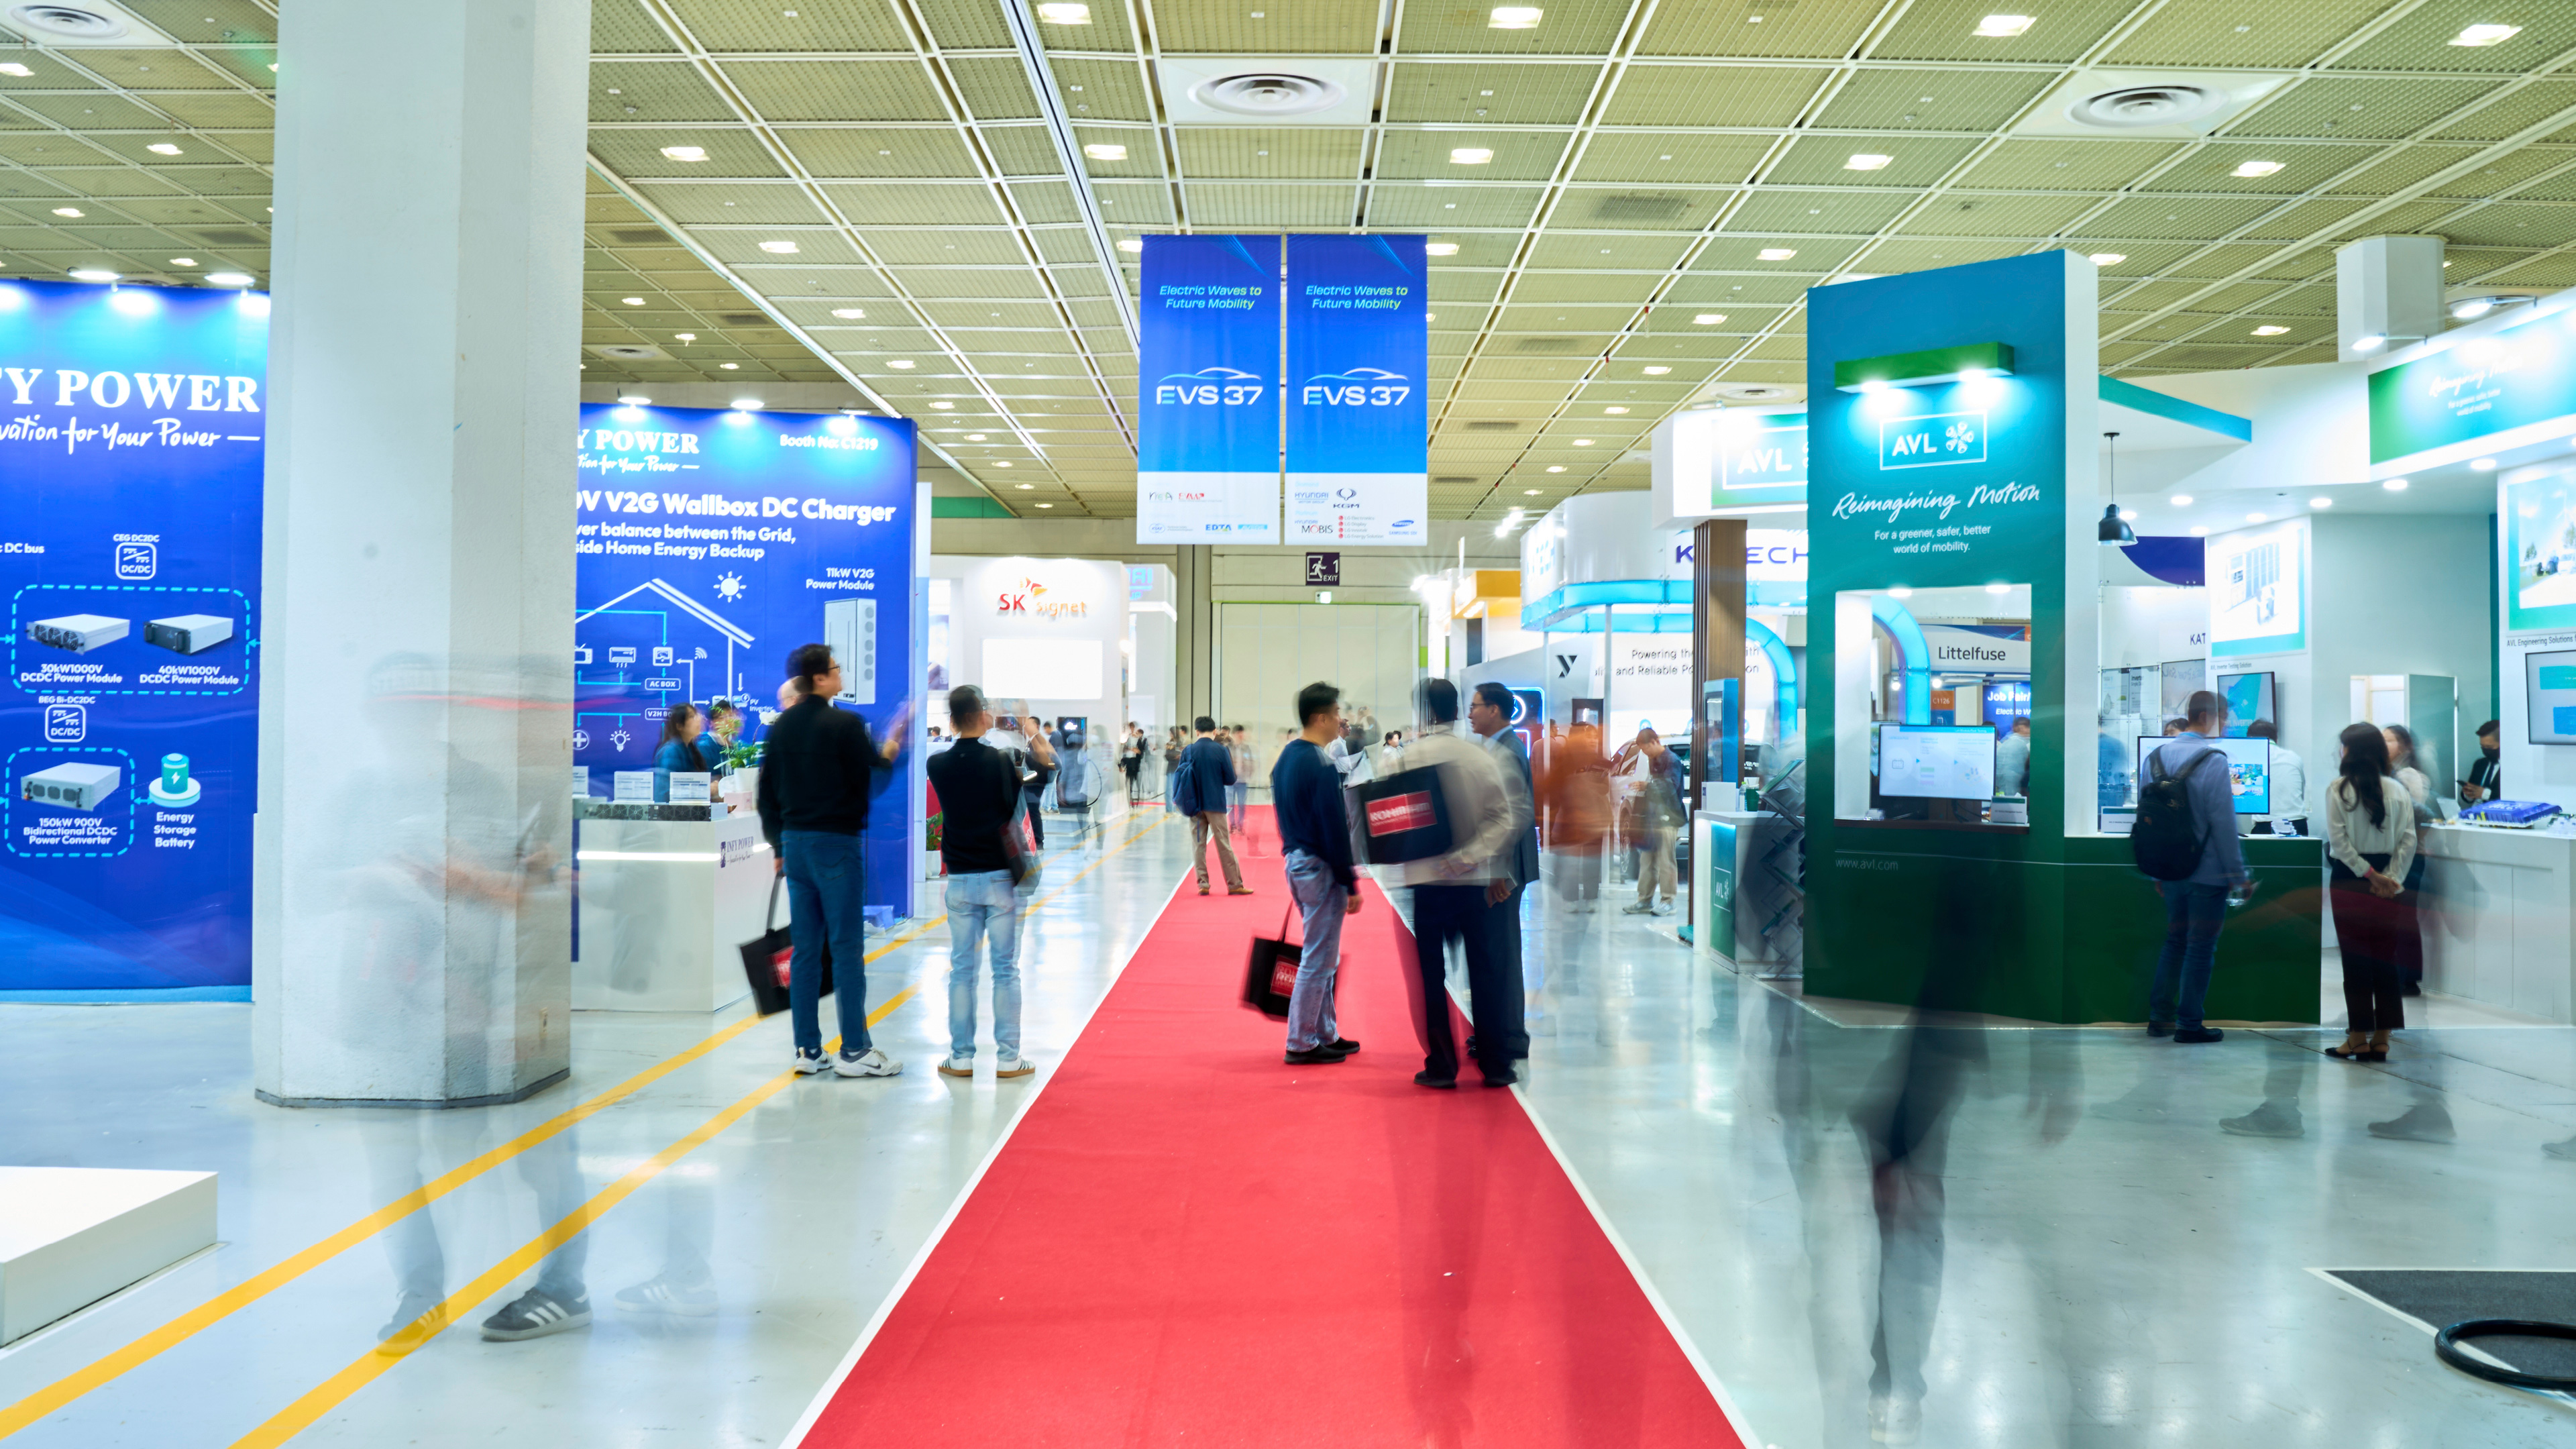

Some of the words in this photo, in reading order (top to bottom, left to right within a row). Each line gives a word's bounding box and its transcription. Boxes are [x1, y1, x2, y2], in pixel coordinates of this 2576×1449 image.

[1159, 285, 1205, 296] Electric
[1208, 285, 1247, 296] Waves
[1250, 286, 1262, 296] to
[1305, 285, 1351, 296] Electric
[1354, 285, 1393, 296] Waves
[1396, 286, 1408, 296] to
[1166, 299, 1205, 309] Future
[1208, 299, 1254, 310] Mobility
[1312, 299, 1351, 309] Future
[1354, 299, 1401, 310] Mobility
[0, 368, 43, 405] Y
[55, 370, 260, 413] POWER
[1157, 385, 1219, 406] EVS
[1224, 385, 1263, 406] 37
[1303, 386, 1366, 406] EVS
[1371, 386, 1409, 406] 37
[62, 417, 99, 455] for
[101, 422, 153, 450] Your
[152, 417, 221, 447] Power
[595, 429, 700, 454] POWER
[780, 434, 816, 448] Booth
[841, 437, 878, 450] C1219
[1892, 433, 1937, 456] AVL
[644, 455, 680, 472] Power
[1737, 448, 1792, 474] AVL
[1832, 490, 1961, 523] Reimagining
[1968, 481, 2040, 508] Motion
[605, 492, 659, 514] V2G
[662, 494, 759, 518] Wallbox
[763, 497, 798, 519] DC
[802, 499, 896, 526] Charger
[602, 522, 661, 538] balance
[664, 524, 728, 540] between
[731, 527, 756, 541] the
[758, 528, 796, 544] Grid,
[1301, 525, 1333, 533] MOBIS
[1874, 530, 1890, 541] For
[1899, 529, 1935, 542] greener,
[1937, 526, 1962, 537] safer,
[1964, 525, 1991, 536] better
[113, 534, 130, 542] CEG
[131, 535, 160, 543] DC2DC
[4, 543, 23, 553] DC
[25, 543, 44, 553] bus
[606, 541, 651, 555] Home
[654, 542, 708, 559] Energy
[710, 544, 765, 561] Backup
[1893, 544, 1919, 553] world
[1920, 543, 1930, 552] of
[1932, 542, 1970, 553] mobility.
[121, 565, 151, 574] DC/DC
[1333, 559, 1339, 573] 1
[826, 568, 850, 578] 11kW
[852, 569, 874, 578] V2G
[806, 580, 837, 589] Power
[839, 580, 874, 590] Module
[999, 594, 1026, 610] SK
[1036, 601, 1087, 616] signet
[2518, 637, 2547, 647] Engineering
[2549, 635, 2573, 643] Solutions
[1632, 649, 1676, 659] Powering
[1939, 646, 2006, 661] Littelfuse
[41, 664, 103, 674] 30kW1000V
[158, 665, 220, 675] 40kW1000V
[1616, 666, 1634, 676] and
[1638, 665, 1677, 675] Reliable
[21, 673, 52, 682] DCDC
[54, 674, 85, 683] Power
[87, 674, 122, 683] Module
[140, 674, 170, 684] DCDC
[172, 675, 203, 684] Power
[204, 676, 239, 685] Module
[1988, 692, 2006, 702] Job
[51, 728, 80, 736] DC/DC
[39, 818, 72, 828] 150kW
[74, 818, 102, 828] 900V
[156, 812, 195, 824] Energy
[23, 826, 85, 836] Bidirectional
[87, 827, 117, 836] DCDC
[154, 825, 197, 836] Storage
[29, 836, 60, 845] Power
[62, 836, 111, 845] Converter
[155, 837, 195, 849] Battery
[727, 840, 738, 853] INFY
[739, 836, 754, 851] POWER
[1835, 857, 1898, 871] www.avl.com
[1715, 882, 1724, 898] AVL
